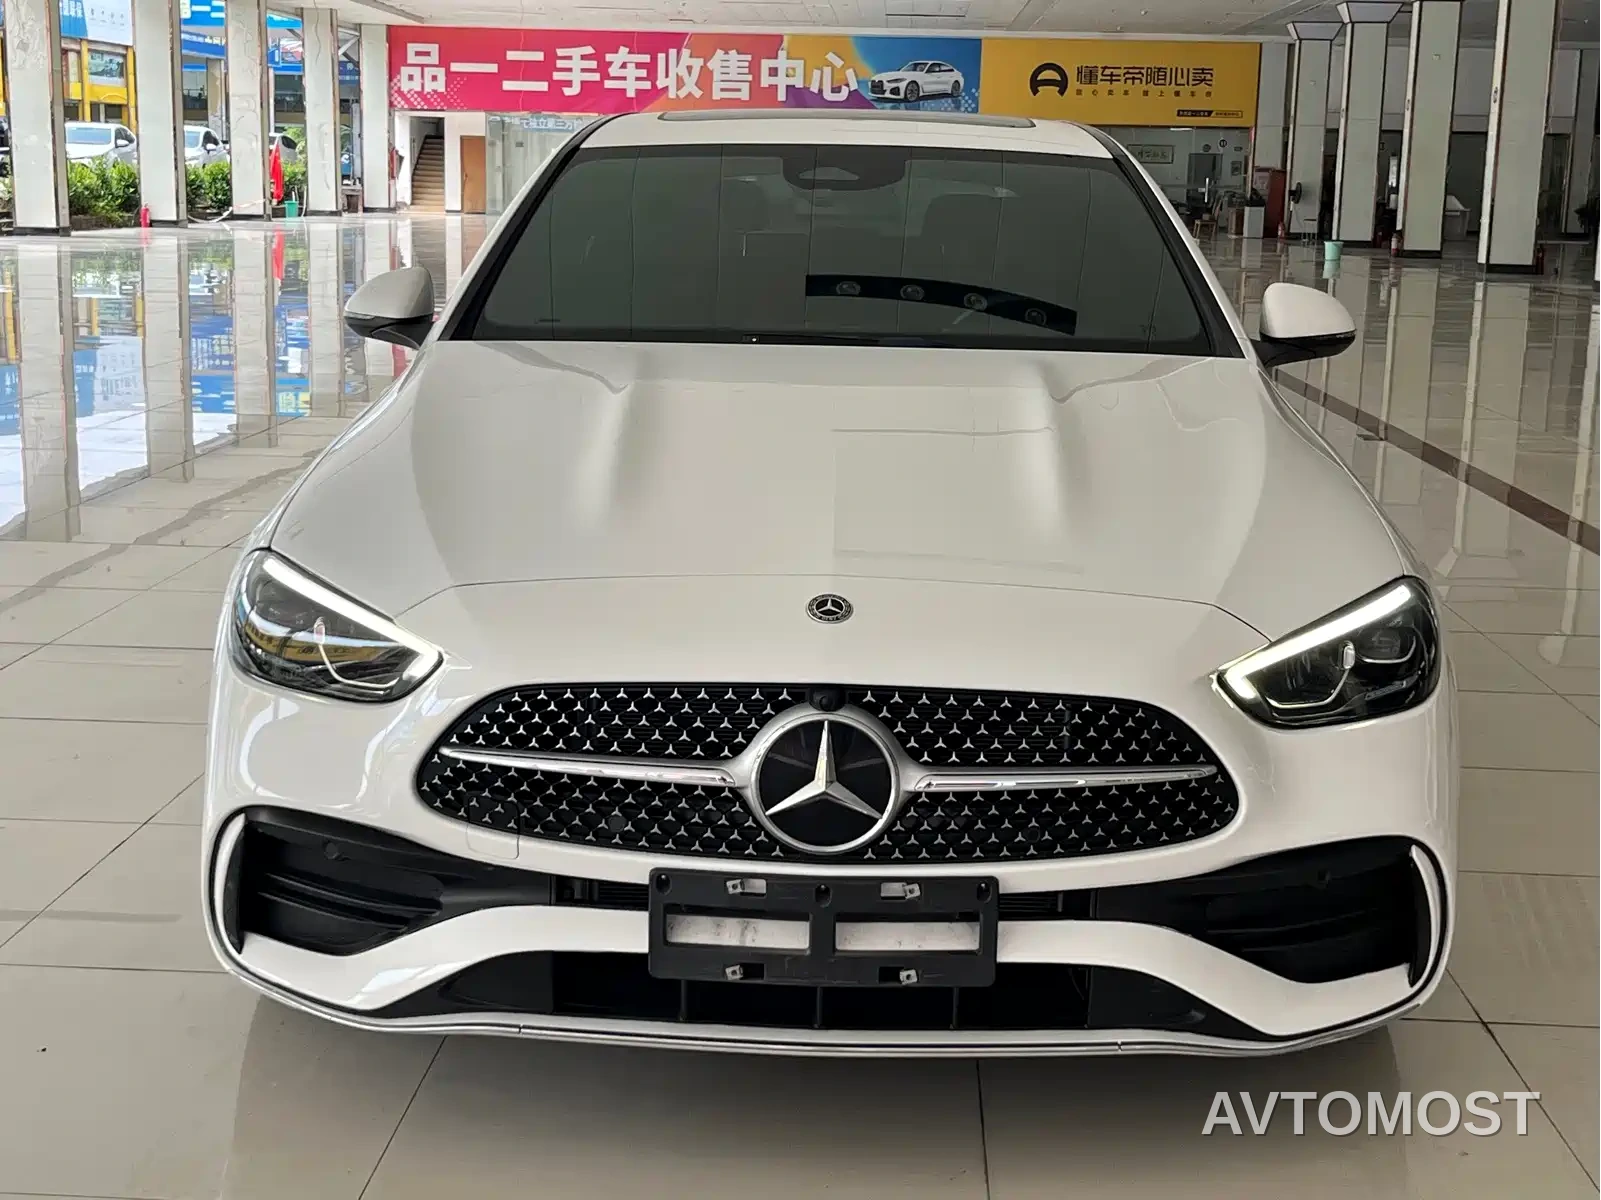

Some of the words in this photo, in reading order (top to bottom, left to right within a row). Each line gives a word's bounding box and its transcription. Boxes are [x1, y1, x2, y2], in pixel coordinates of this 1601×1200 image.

[400, 43, 858, 102] 品一二手车收售中心
[1076, 65, 1214, 87] 懂车帝随心卖
